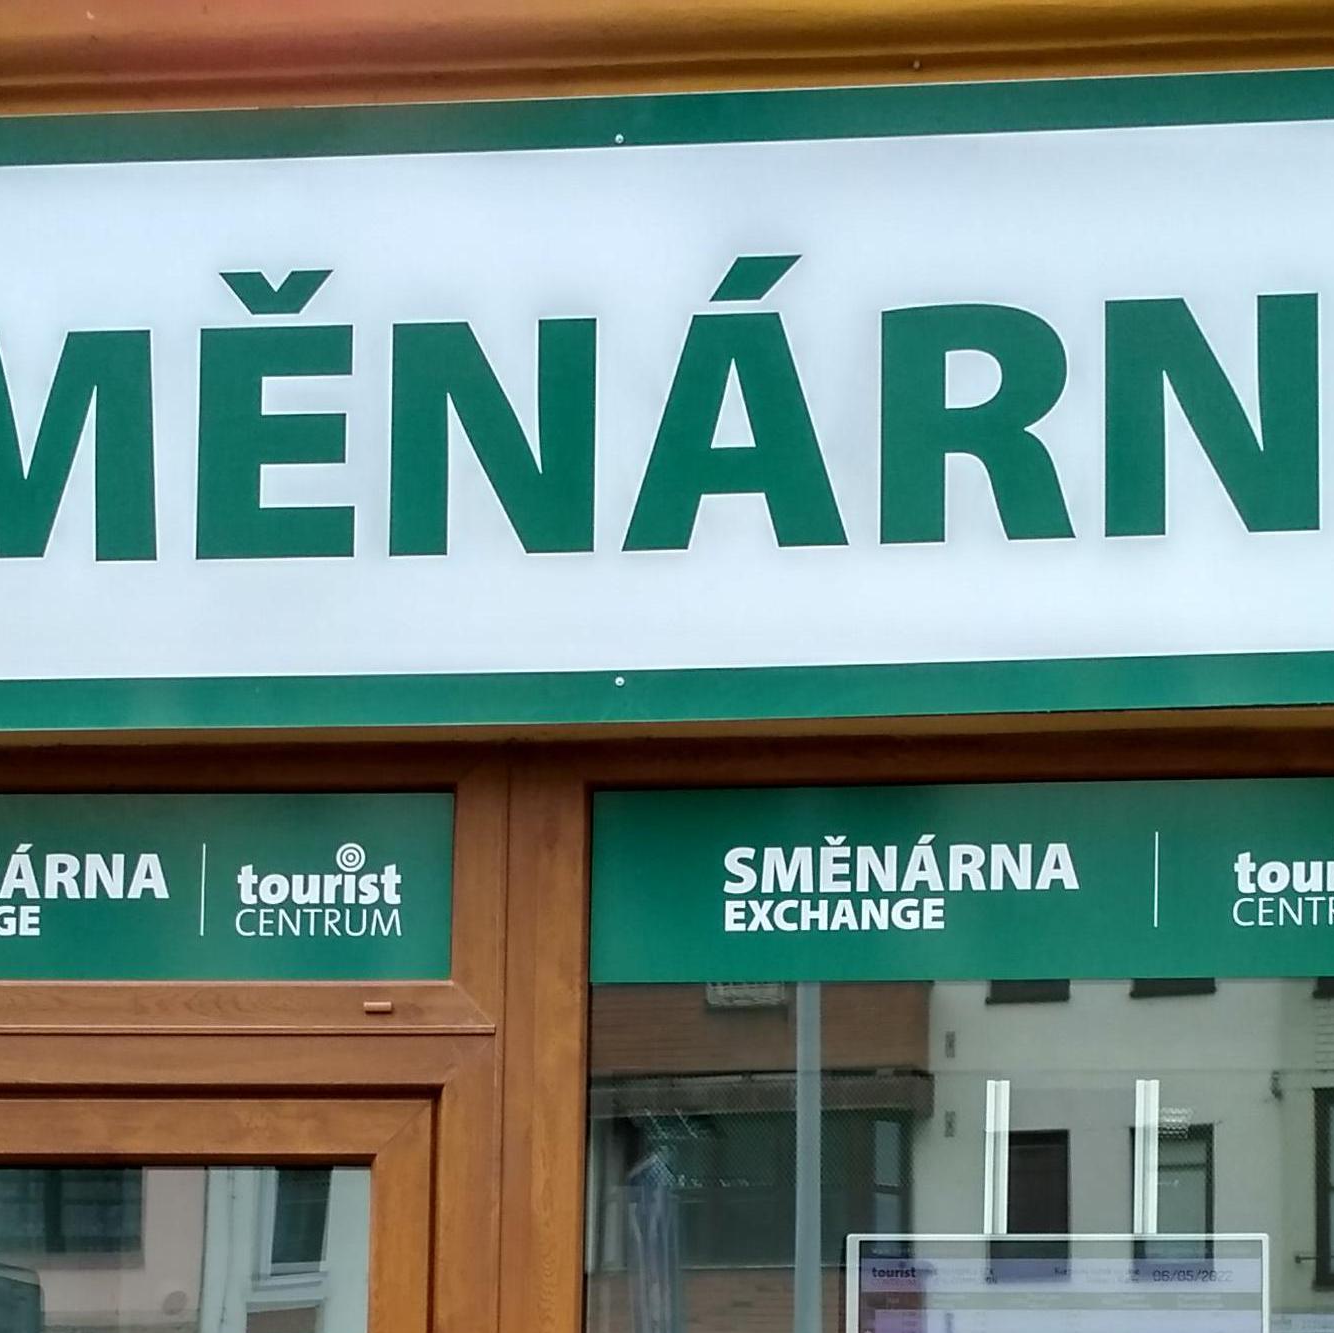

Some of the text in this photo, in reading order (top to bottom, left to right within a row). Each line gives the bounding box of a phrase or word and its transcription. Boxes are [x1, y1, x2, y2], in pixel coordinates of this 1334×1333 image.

[724, 835, 1079, 894] SMĚNÁRNA
[238, 864, 401, 904] tourist
[236, 909, 401, 936] CENTRUM
[725, 898, 944, 931] EXCHANGE
